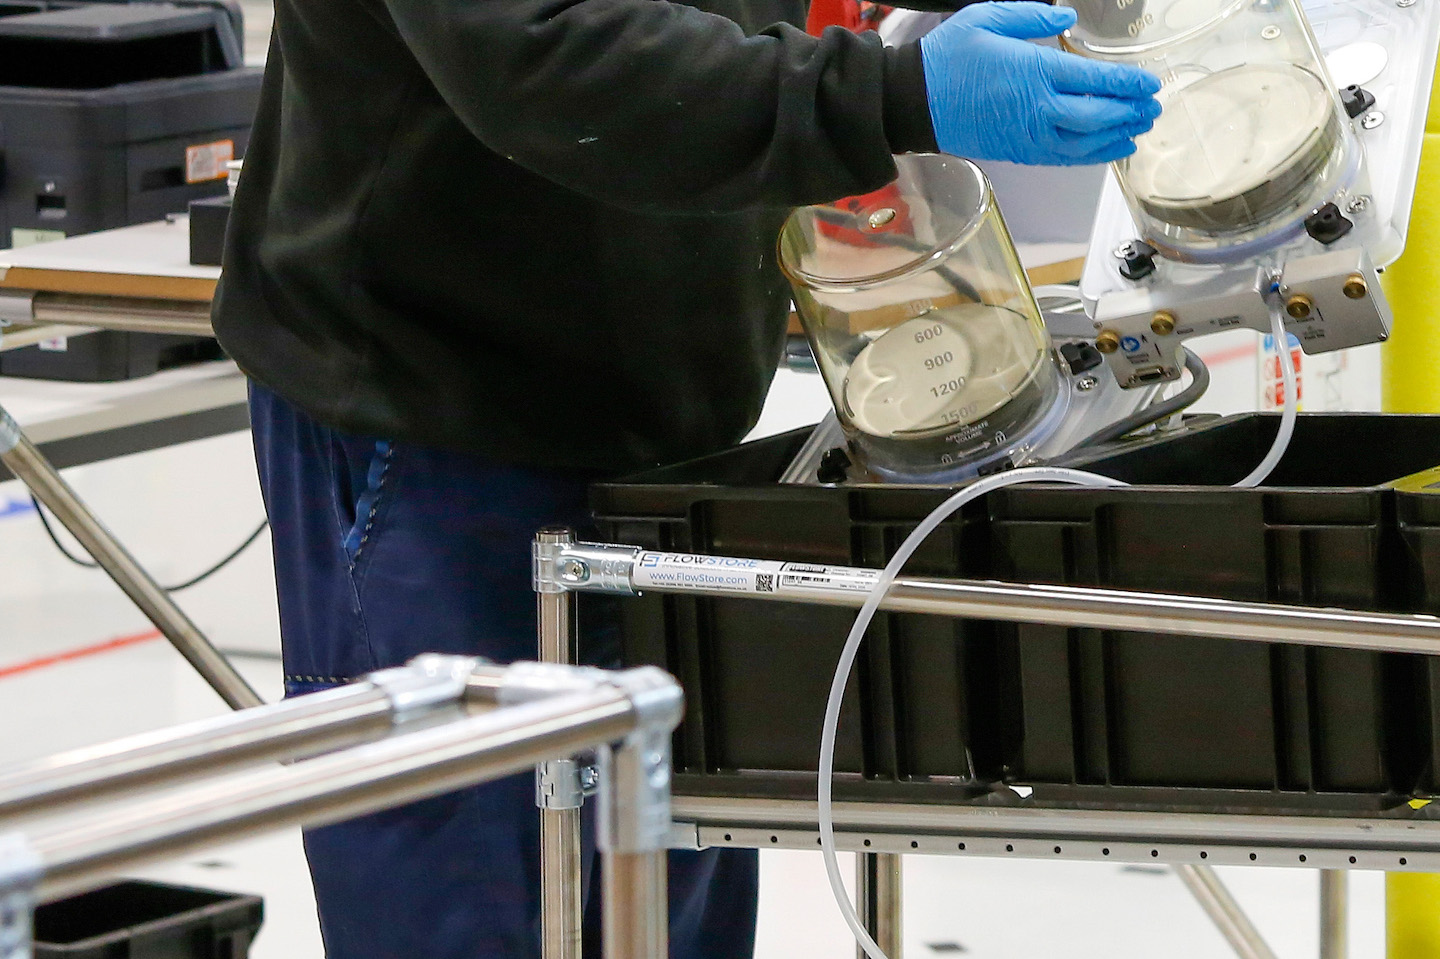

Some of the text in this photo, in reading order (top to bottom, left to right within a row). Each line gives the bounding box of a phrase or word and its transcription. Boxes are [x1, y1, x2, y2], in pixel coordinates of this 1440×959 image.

[914, 324, 943, 344] 600
[924, 351, 954, 371] 900
[930, 376, 966, 398] 1200
[941, 402, 979, 424] 1500
[664, 554, 760, 568] FLOWSTORE
[649, 572, 748, 585] www.FlowStore.com
